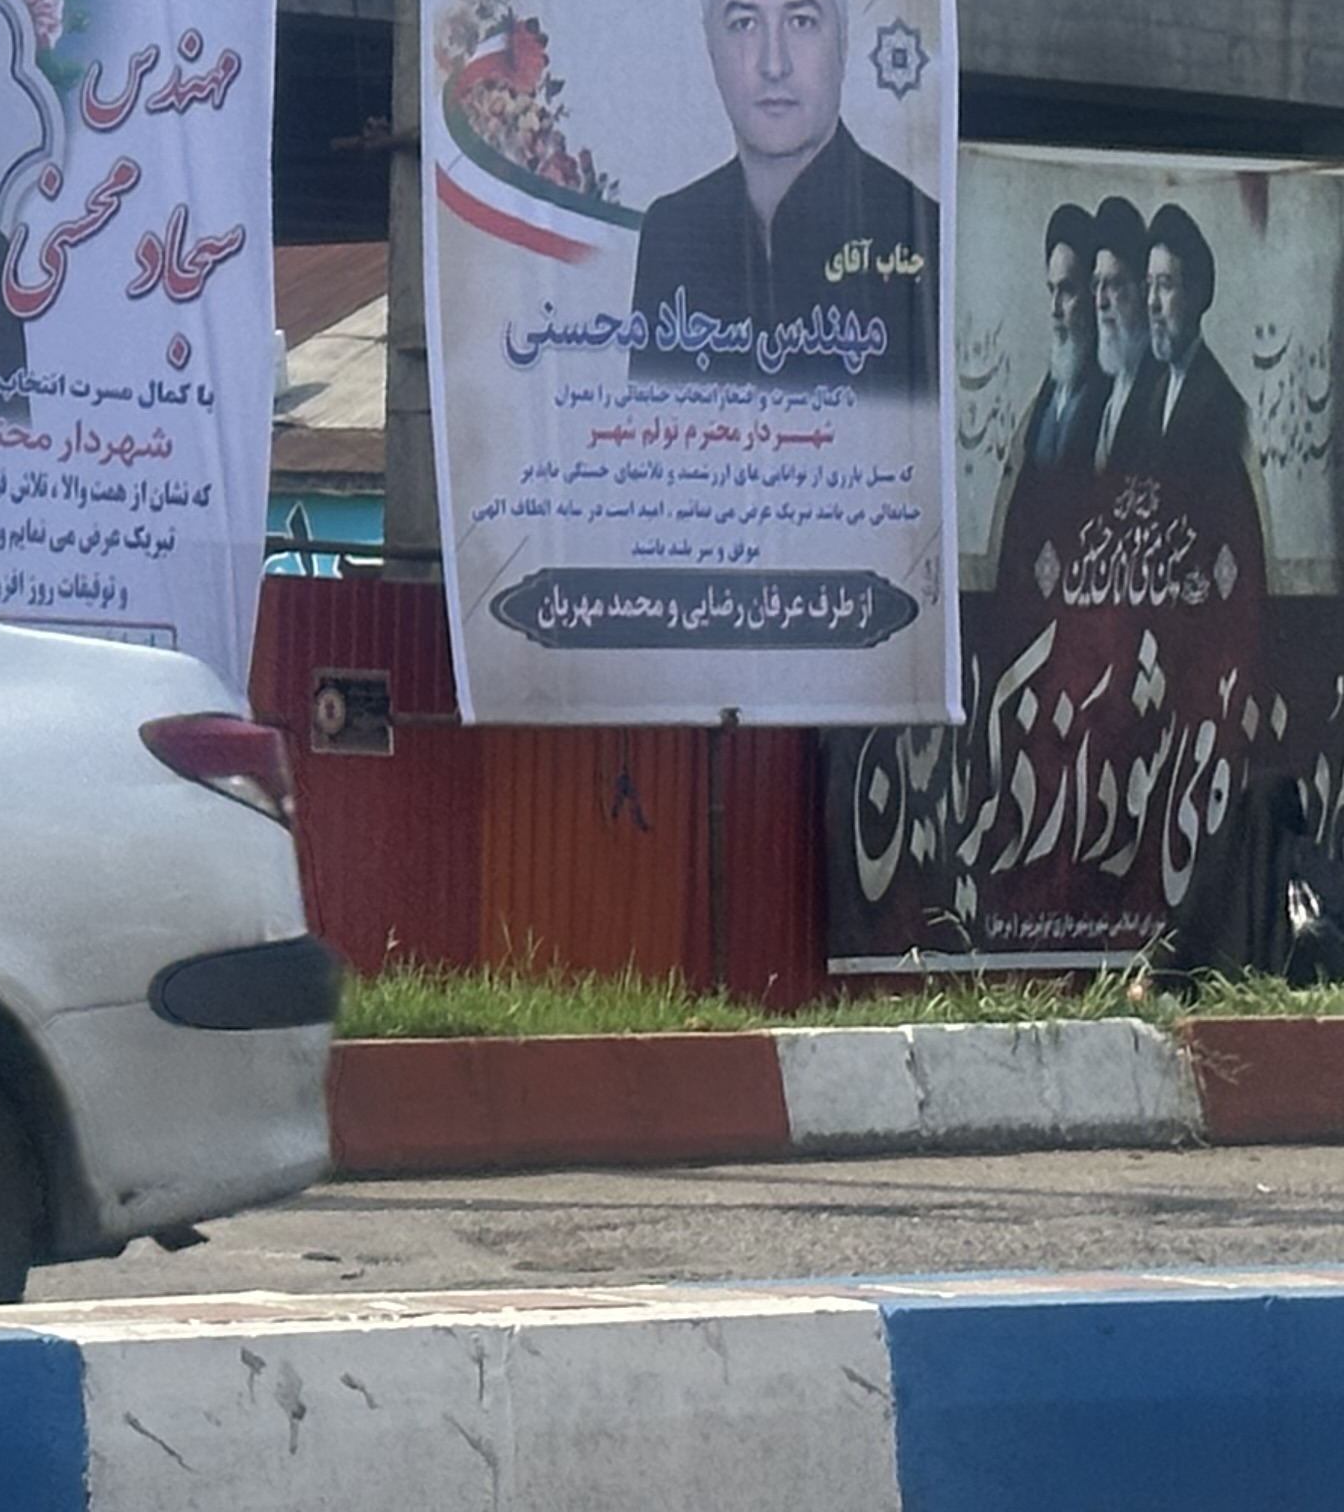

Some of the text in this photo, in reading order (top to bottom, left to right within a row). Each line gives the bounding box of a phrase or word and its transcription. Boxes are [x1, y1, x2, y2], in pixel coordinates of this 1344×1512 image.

[81, 29, 240, 129] مهندس
[3, 157, 245, 370] سجاد محسنی
[824, 238, 926, 285] جناب آقای
[504, 286, 888, 374] مهندس سجاد محسنی
[70, 378, 132, 405] مسرت
[138, 378, 191, 408] کمال
[196, 384, 214, 413] با
[57, 419, 173, 467] شهردار
[130, 478, 146, 511] از
[150, 478, 189, 511] نشان
[193, 484, 212, 507] که
[49, 528, 75, 553] می
[78, 530, 120, 556] عرض
[124, 524, 175, 559] تبریک
[536, 583, 873, 630] از طرف عرفان رضایی و محمد مهربان
